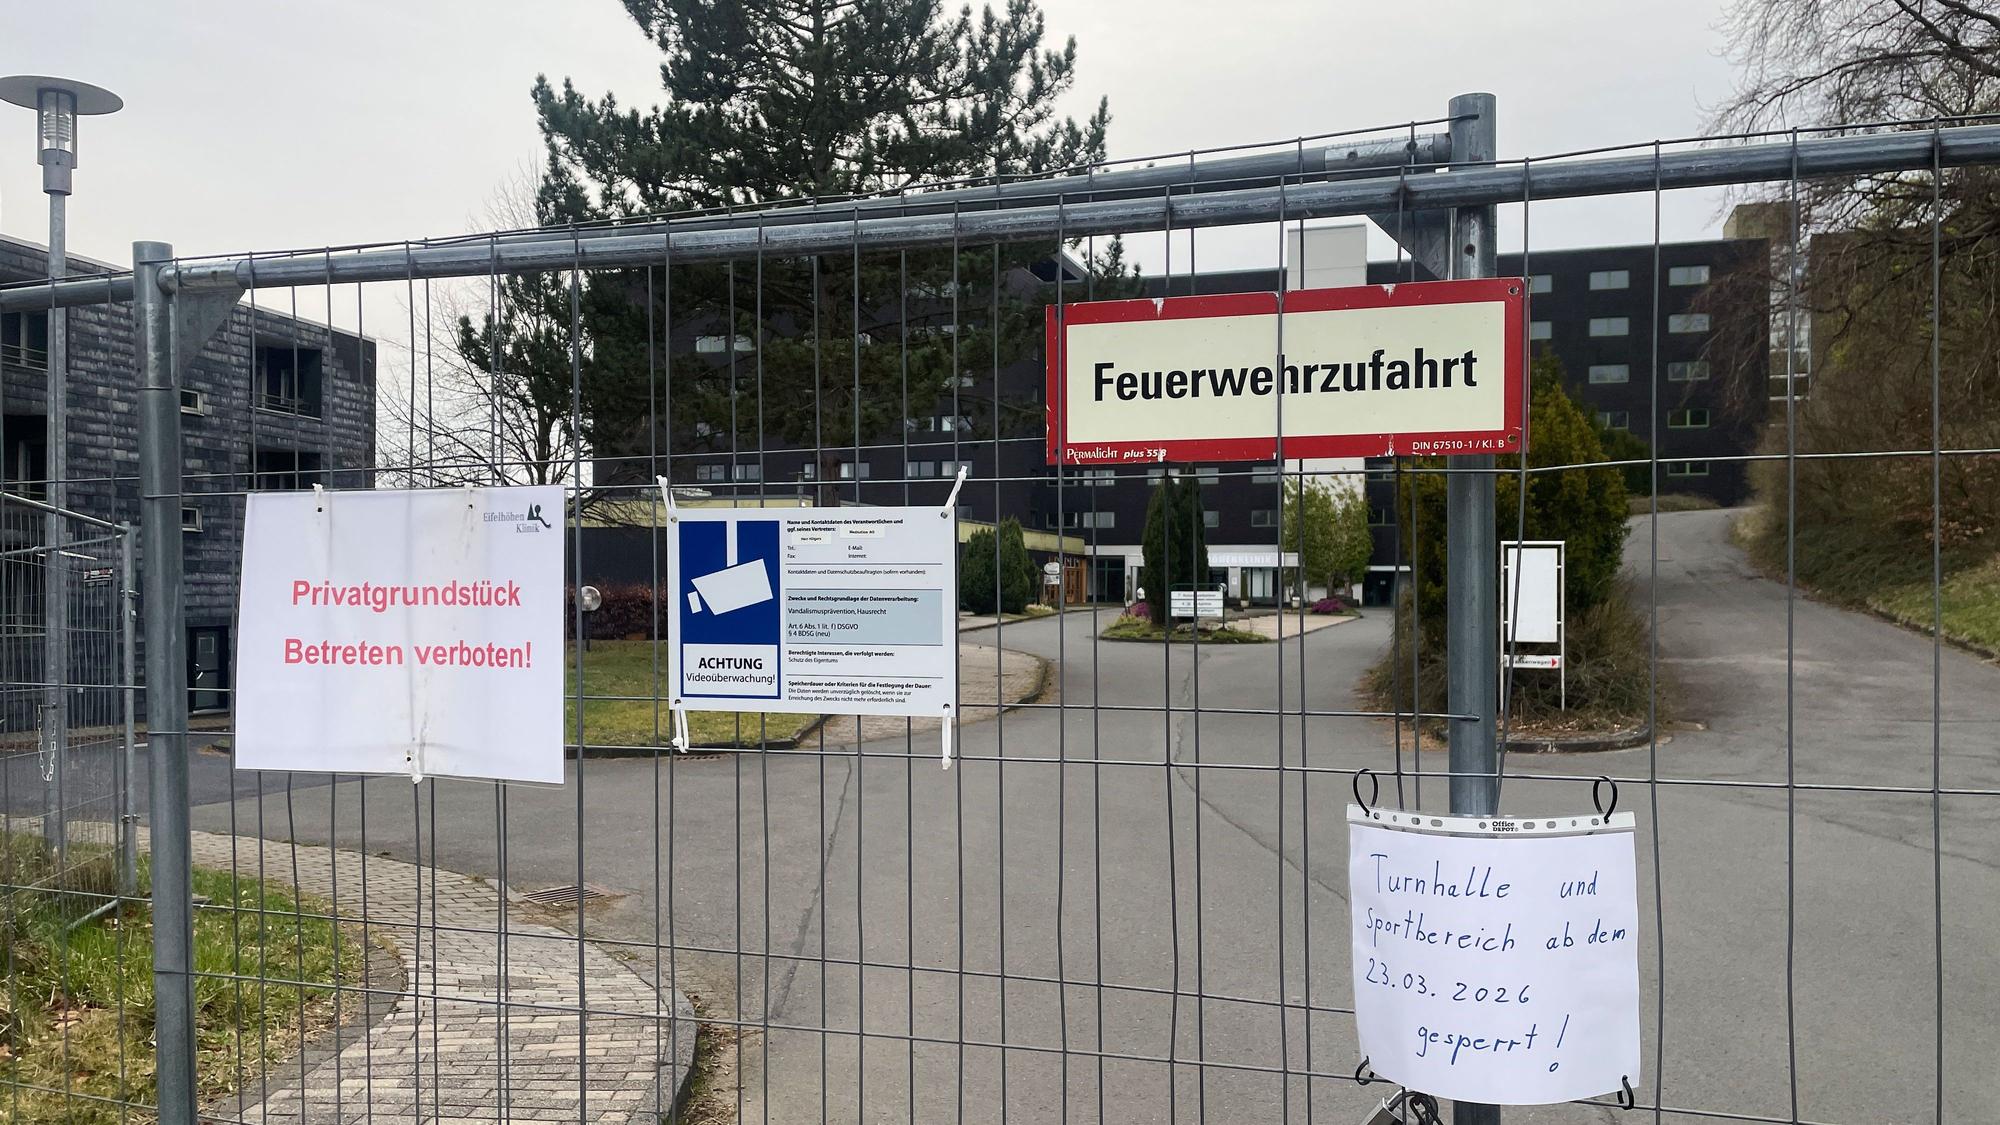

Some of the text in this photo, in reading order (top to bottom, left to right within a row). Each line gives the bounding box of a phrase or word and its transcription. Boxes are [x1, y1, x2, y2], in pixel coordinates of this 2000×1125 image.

[1094, 347, 1478, 402] Feuerwehrzufahrt
[1412, 441, 1430, 450] DIN
[1498, 440, 1505, 448] B
[1124, 449, 1144, 459] plus
[483, 512, 525, 522] Eifelhöhen
[516, 523, 540, 533] Klinik
[292, 580, 521, 613] Privatgrundstück
[831, 623, 836, 631] f)
[284, 639, 532, 669] Betreten verboten!
[698, 657, 763, 670] ACHTUNG
[686, 672, 775, 685] Videoüberwachung!
[1370, 853, 1598, 899] Turnhalle und
[1366, 907, 1626, 952] Sportbereich ab dem
[1452, 982, 1530, 1004] 2026
